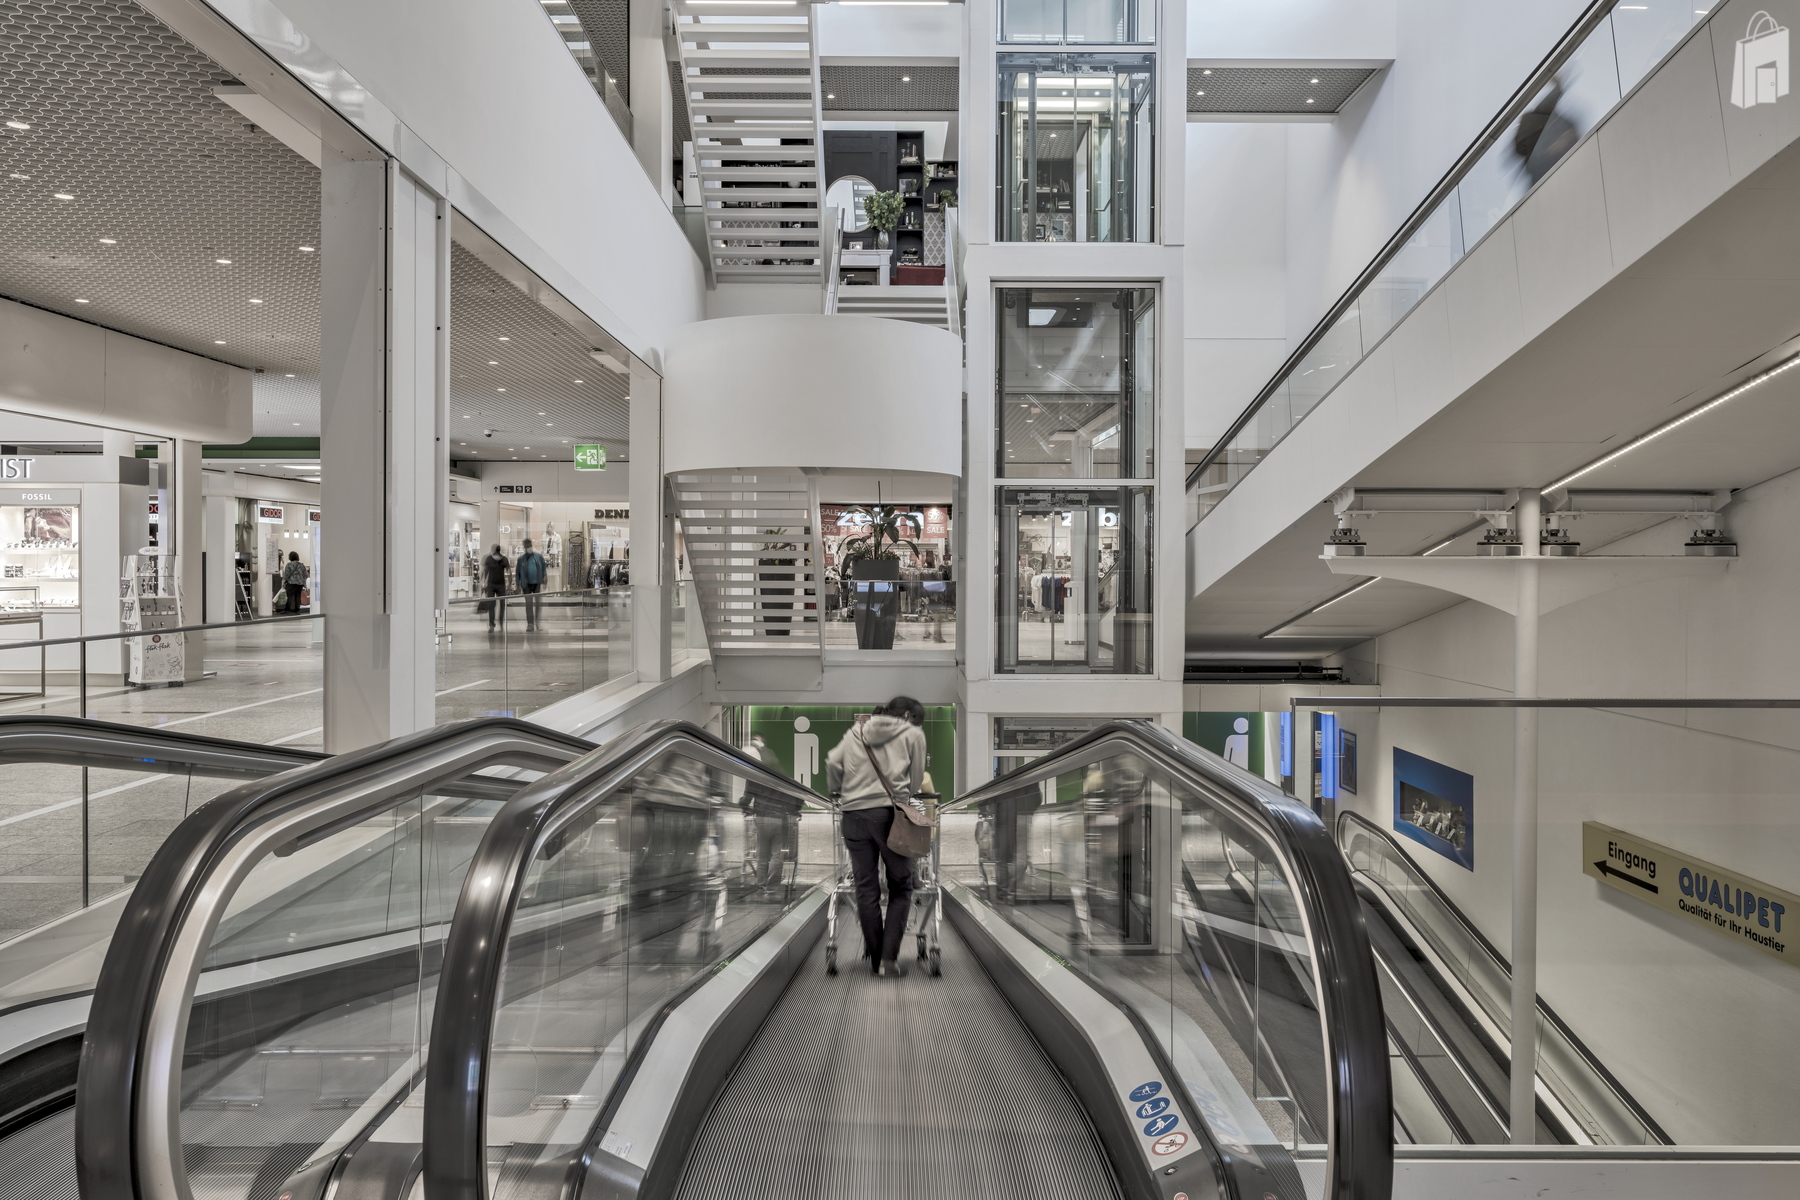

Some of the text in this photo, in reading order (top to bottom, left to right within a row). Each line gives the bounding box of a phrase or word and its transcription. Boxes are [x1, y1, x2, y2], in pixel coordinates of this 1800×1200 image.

[0, 458, 34, 478] IST
[22, 493, 52, 501] FOSSIL
[263, 508, 282, 518] GIDOR
[594, 509, 630, 519] DENI
[927, 526, 945, 534] SALE
[1608, 841, 1656, 879] Eingang
[1678, 867, 1785, 933] QUALIPET
[1678, 898, 1785, 953] Qualität für Ihr Haustier
